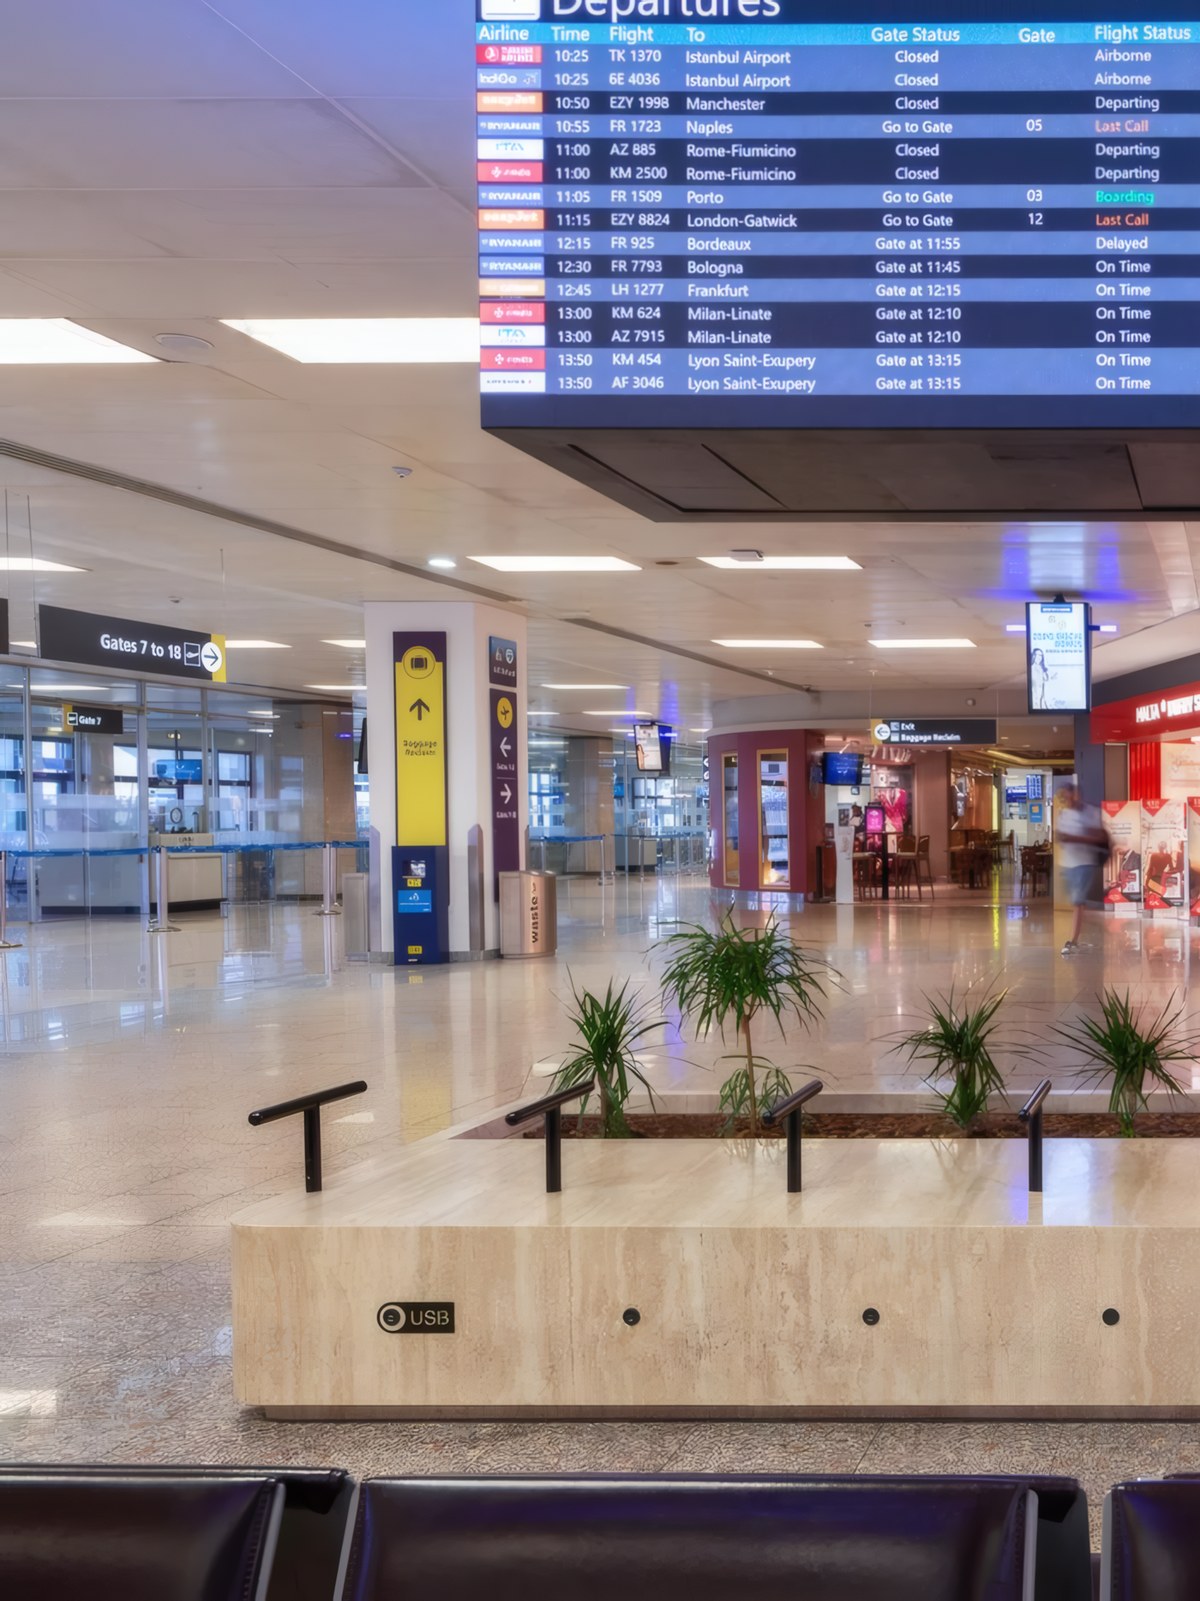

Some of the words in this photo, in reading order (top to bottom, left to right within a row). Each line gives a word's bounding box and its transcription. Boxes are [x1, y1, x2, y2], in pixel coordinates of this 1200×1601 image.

[479, 24, 528, 40] Airline
[551, 26, 590, 41] Time
[610, 25, 653, 44] Flight
[687, 27, 705, 42] To
[871, 27, 908, 42] Gate
[912, 27, 960, 42] Status
[1018, 28, 1055, 43] Gate
[1095, 25, 1138, 43] Flight
[1144, 25, 1191, 40] Status
[555, 50, 589, 62] 10:25
[609, 49, 625, 62] TK
[631, 49, 661, 62] 1370
[686, 51, 739, 64] Istanbul
[743, 50, 791, 67] Airport
[895, 50, 939, 63] Closed
[1095, 49, 1152, 61] Airborne
[555, 73, 589, 86] 10:25
[609, 73, 624, 85] 6E
[628, 73, 660, 85] 4036
[686, 74, 739, 87] Istanbul
[743, 74, 791, 90] Airport
[895, 73, 938, 86] Closed
[1095, 72, 1152, 85] Airborne
[556, 120, 590, 133] 10:55
[610, 120, 626, 132] FR
[631, 120, 661, 132] 1723
[687, 120, 733, 136] Naples
[882, 121, 901, 133] Go
[905, 122, 919, 133] to
[922, 121, 953, 133] Gate
[1026, 119, 1042, 131] 05
[1095, 120, 1121, 133] Last
[1124, 120, 1149, 132] Call
[557, 214, 591, 226] 11:15
[611, 213, 635, 225] EZY
[638, 213, 670, 226] 8824
[687, 214, 797, 227] London-Gatwick
[883, 214, 902, 226] Go
[905, 215, 919, 226] to
[923, 214, 953, 226] Gate
[1029, 213, 1043, 225] 12
[1096, 214, 1121, 226] Last
[1125, 213, 1149, 226] Call
[557, 237, 591, 249] 12:15
[611, 236, 627, 248] FR
[631, 237, 654, 249] 925
[687, 237, 751, 251] Bordeaux
[875, 237, 906, 249] Gate
[909, 239, 922, 249] at
[927, 237, 960, 250] 11:55
[1096, 236, 1148, 252] Delayed
[559, 377, 592, 389] 13:50
[612, 376, 629, 388] AF
[633, 376, 664, 388] 3046
[688, 377, 719, 393] Lyon
[723, 377, 816, 393] Saint-Exupery
[876, 377, 906, 390] Gate
[910, 379, 922, 389] at
[927, 377, 961, 389] 13:15
[1096, 377, 1116, 389] On
[1119, 377, 1151, 389] Time
[100, 634, 137, 653] Gates
[140, 640, 148, 654] 7
[151, 642, 164, 657] to
[168, 644, 182, 660] 18
[79, 717, 96, 725] Gate
[97, 717, 101, 725] 7
[410, 1310, 449, 1326] USB
